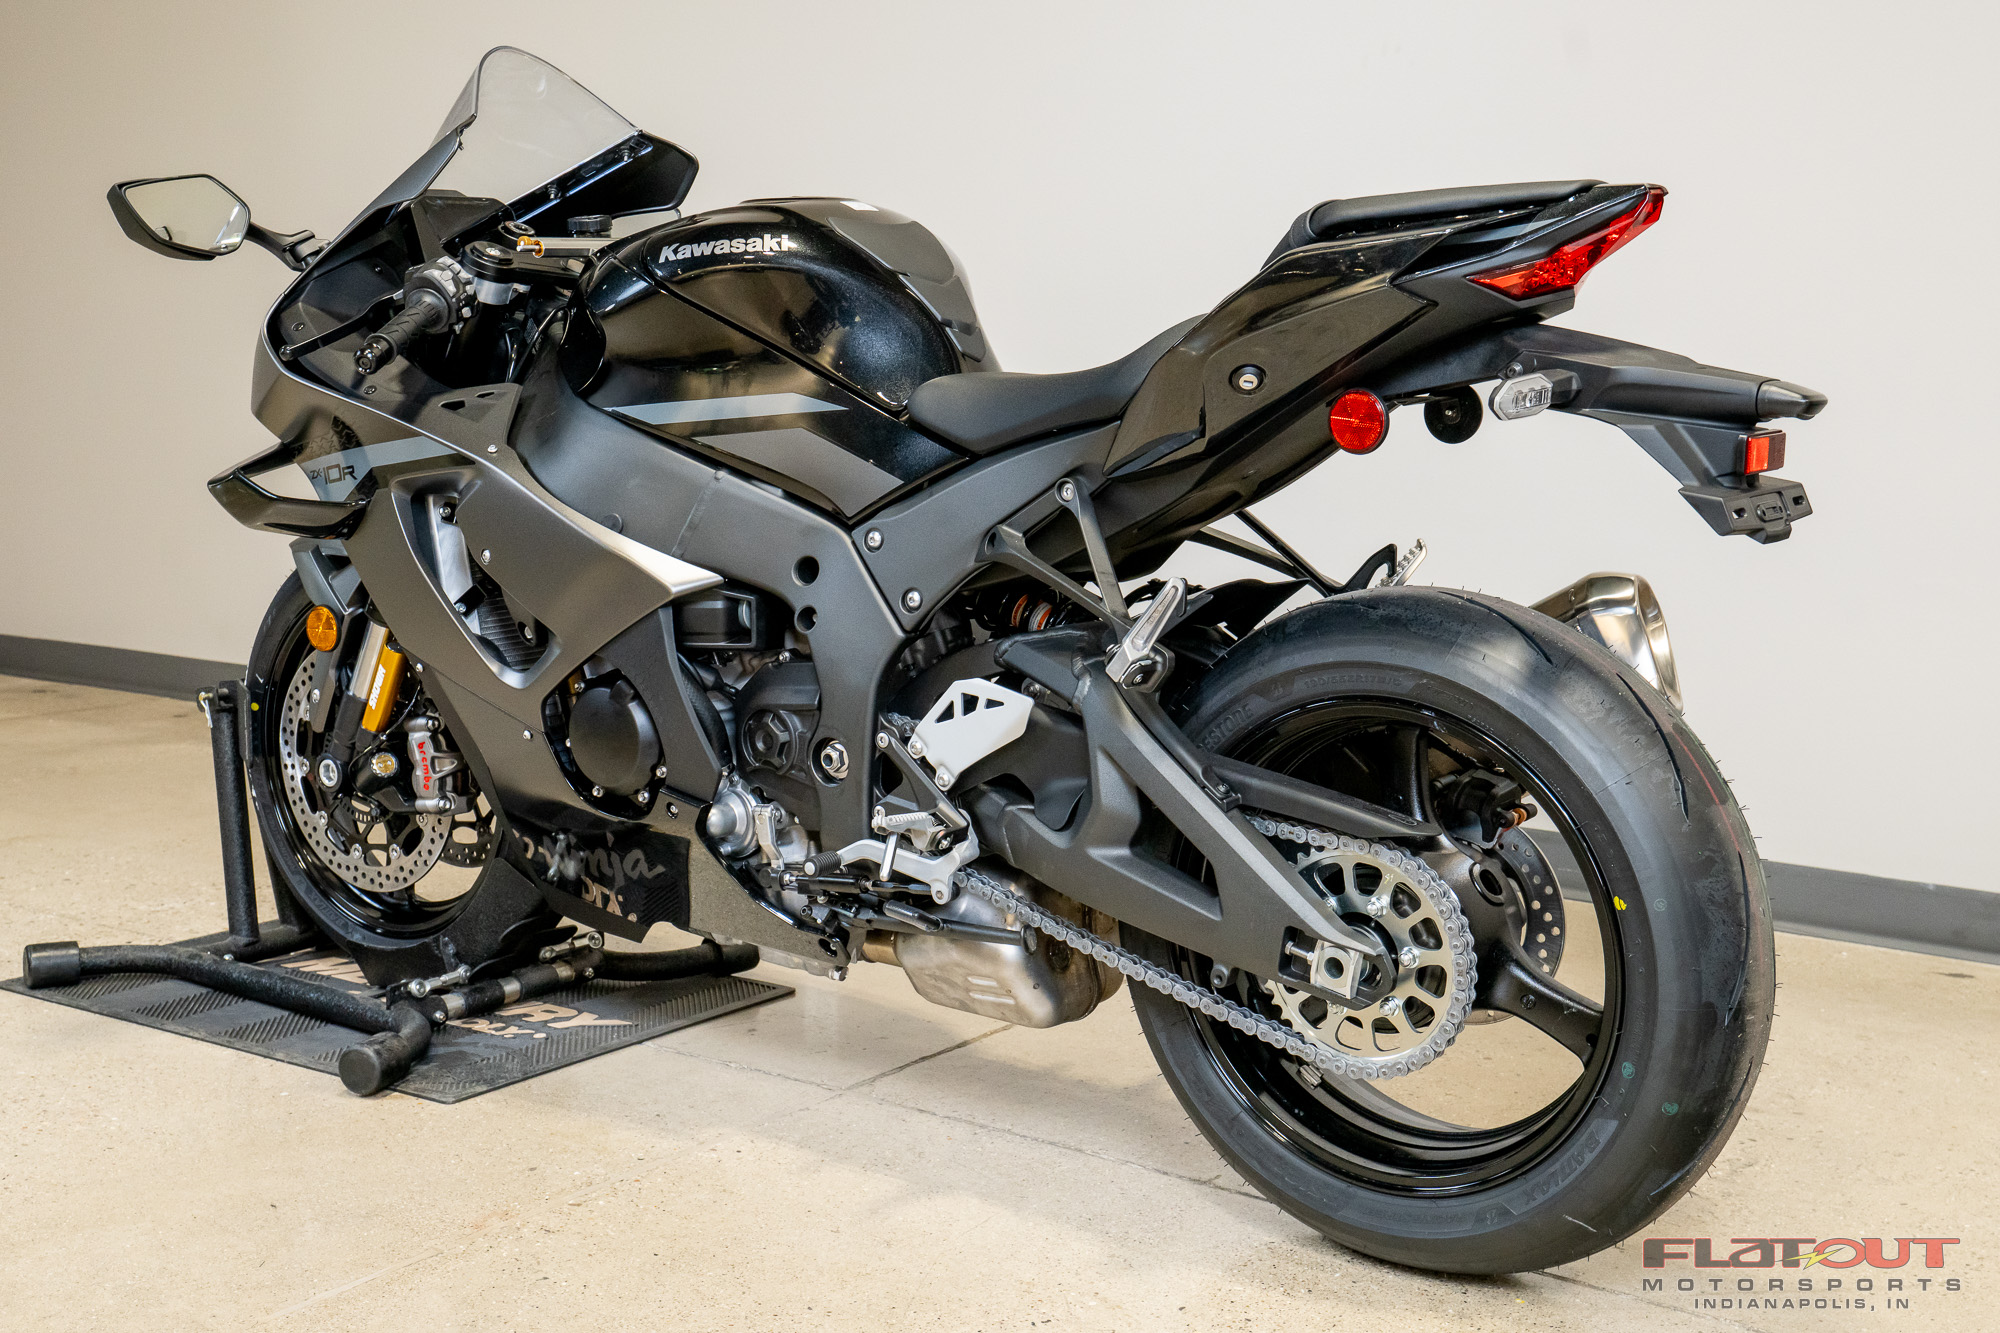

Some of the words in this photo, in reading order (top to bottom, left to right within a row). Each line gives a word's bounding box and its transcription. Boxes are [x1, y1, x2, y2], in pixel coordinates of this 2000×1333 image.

[658, 233, 790, 264] Kawasaki
[369, 663, 386, 710] SHOWA
[417, 741, 431, 791] brembo
